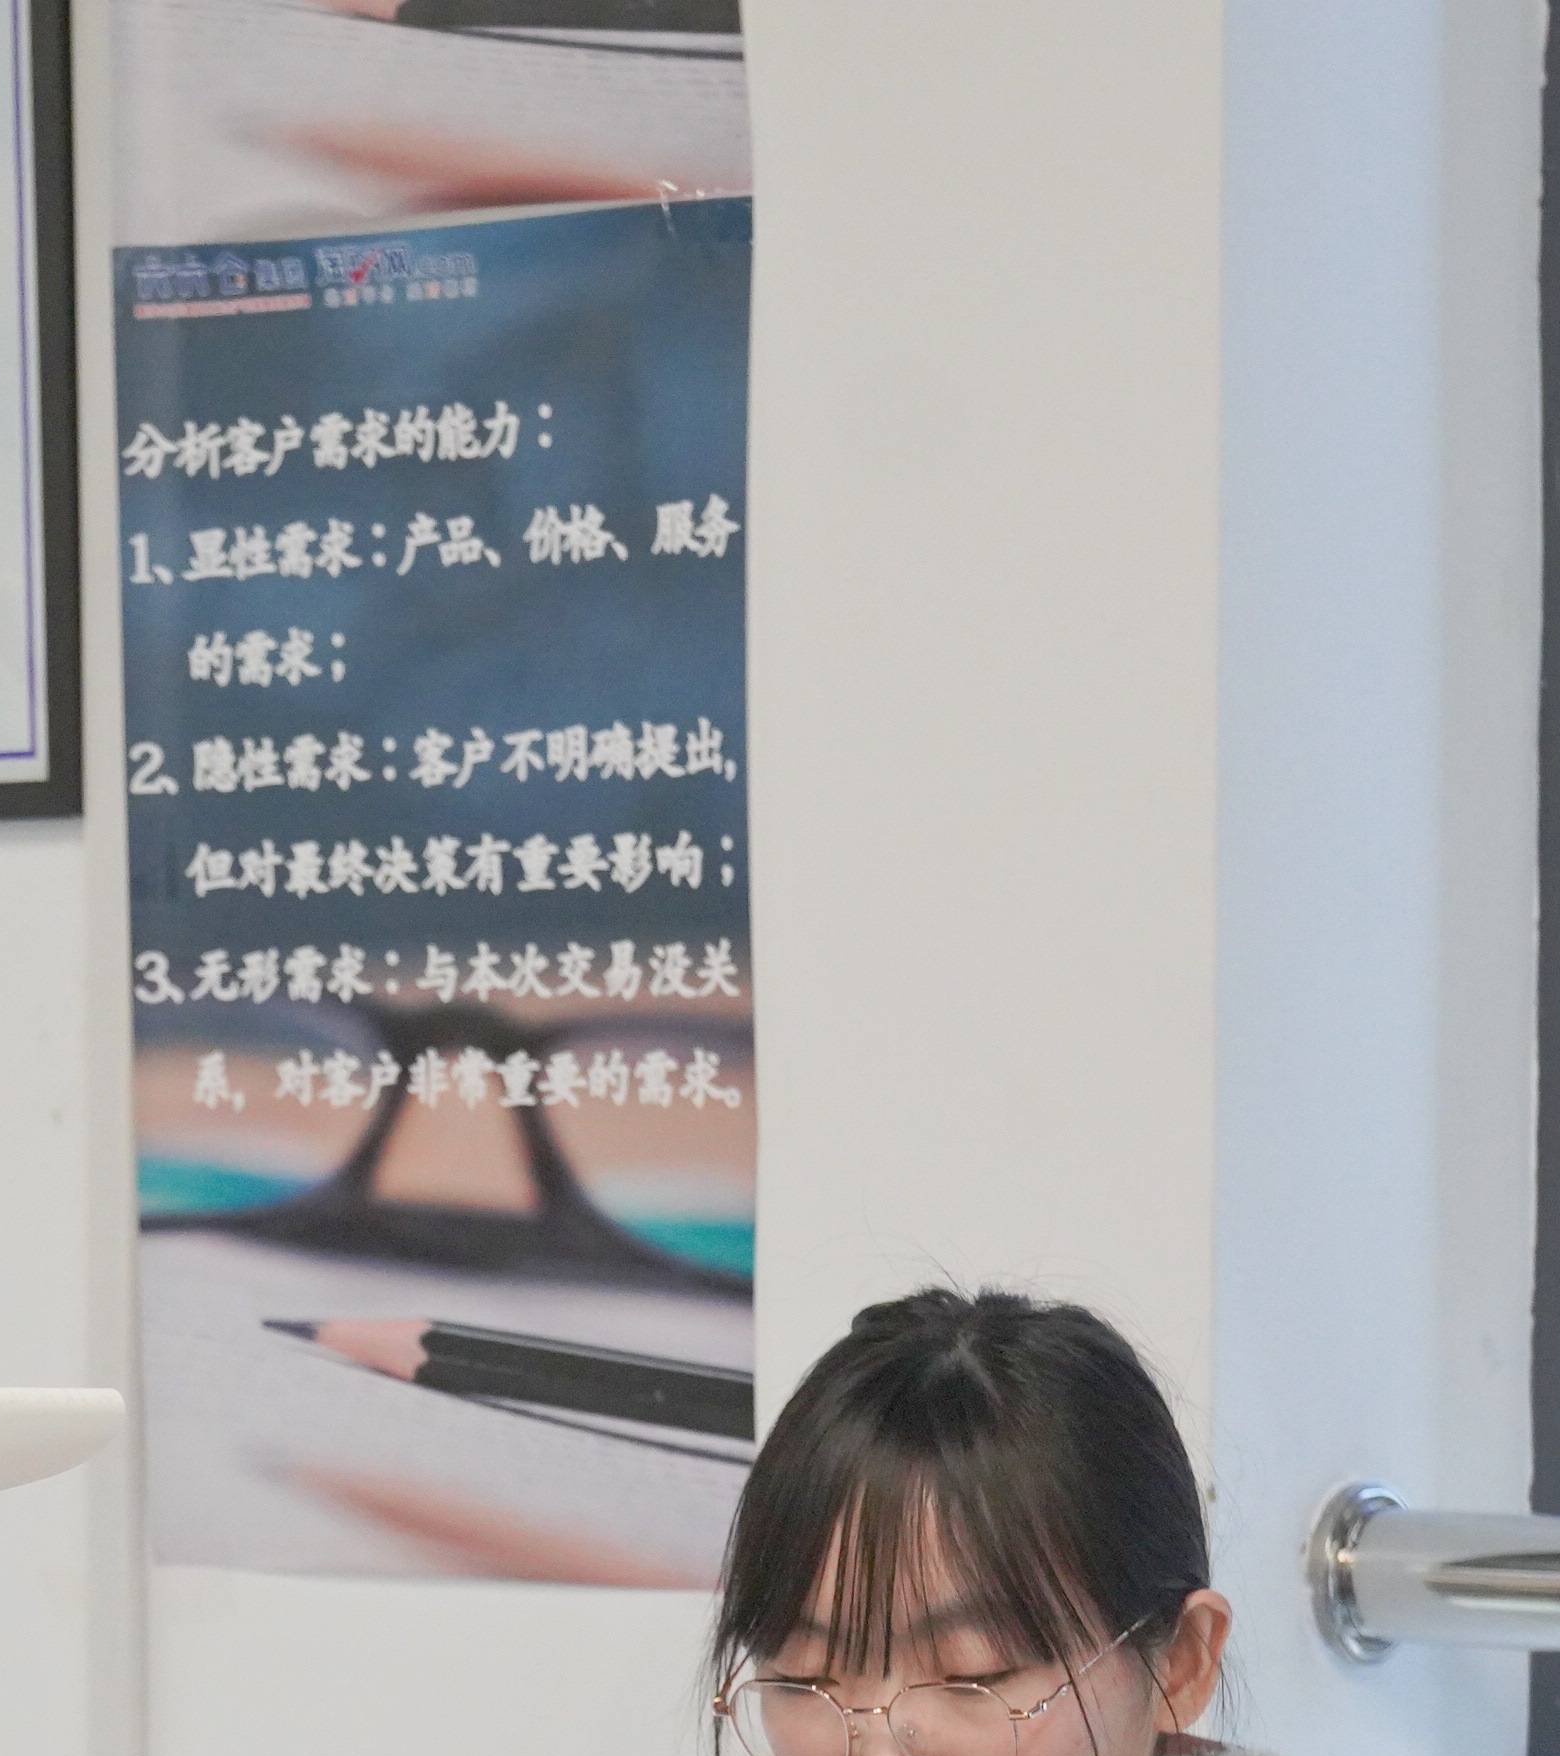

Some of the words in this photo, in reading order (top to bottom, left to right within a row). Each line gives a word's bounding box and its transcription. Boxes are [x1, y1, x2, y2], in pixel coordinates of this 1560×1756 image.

[123, 401, 553, 479] 分析客户需求的能力：
[188, 626, 346, 687] 的需求；
[186, 830, 734, 898] 但对最终决策有重要影响；
